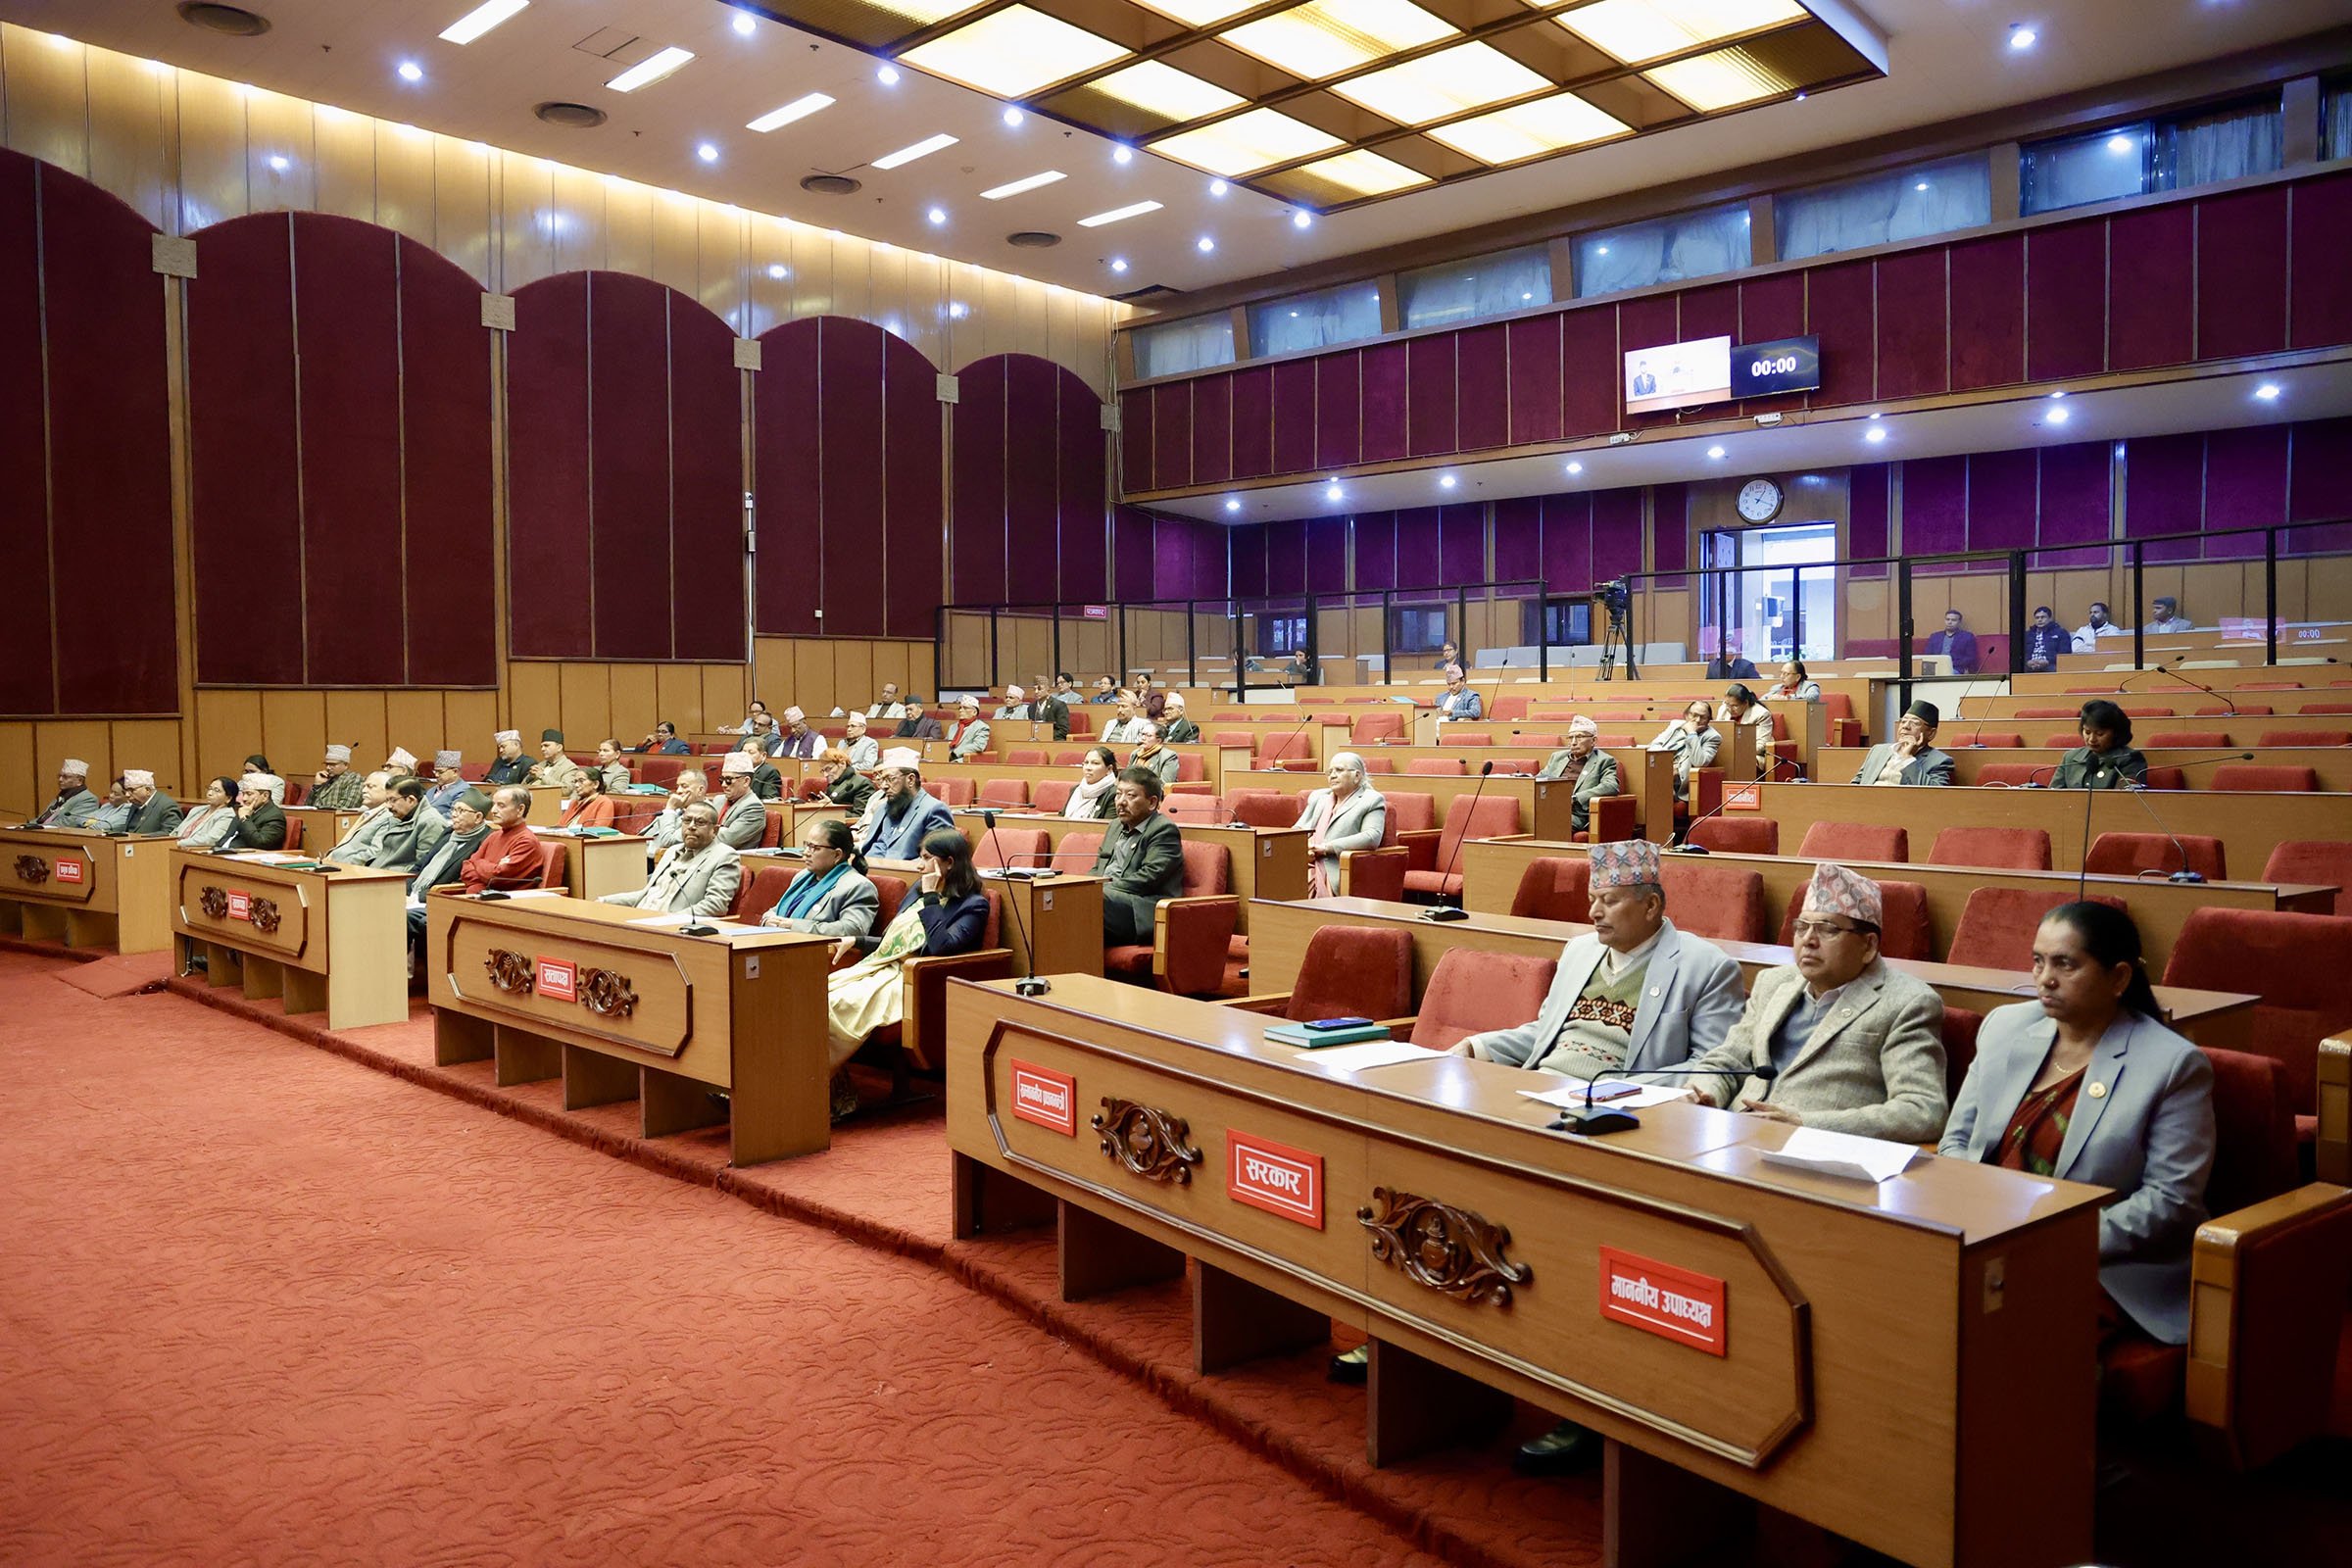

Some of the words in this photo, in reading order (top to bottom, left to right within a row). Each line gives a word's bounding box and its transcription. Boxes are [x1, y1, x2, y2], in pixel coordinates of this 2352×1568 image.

[1751, 356, 1796, 377] 00:00
[2298, 629, 2321, 638] 00:00
[1246, 1156, 1302, 1196] सरकार
[1611, 1274, 1659, 1309] माननीय
[1661, 1290, 1713, 1329] उपाध्यक्ष
